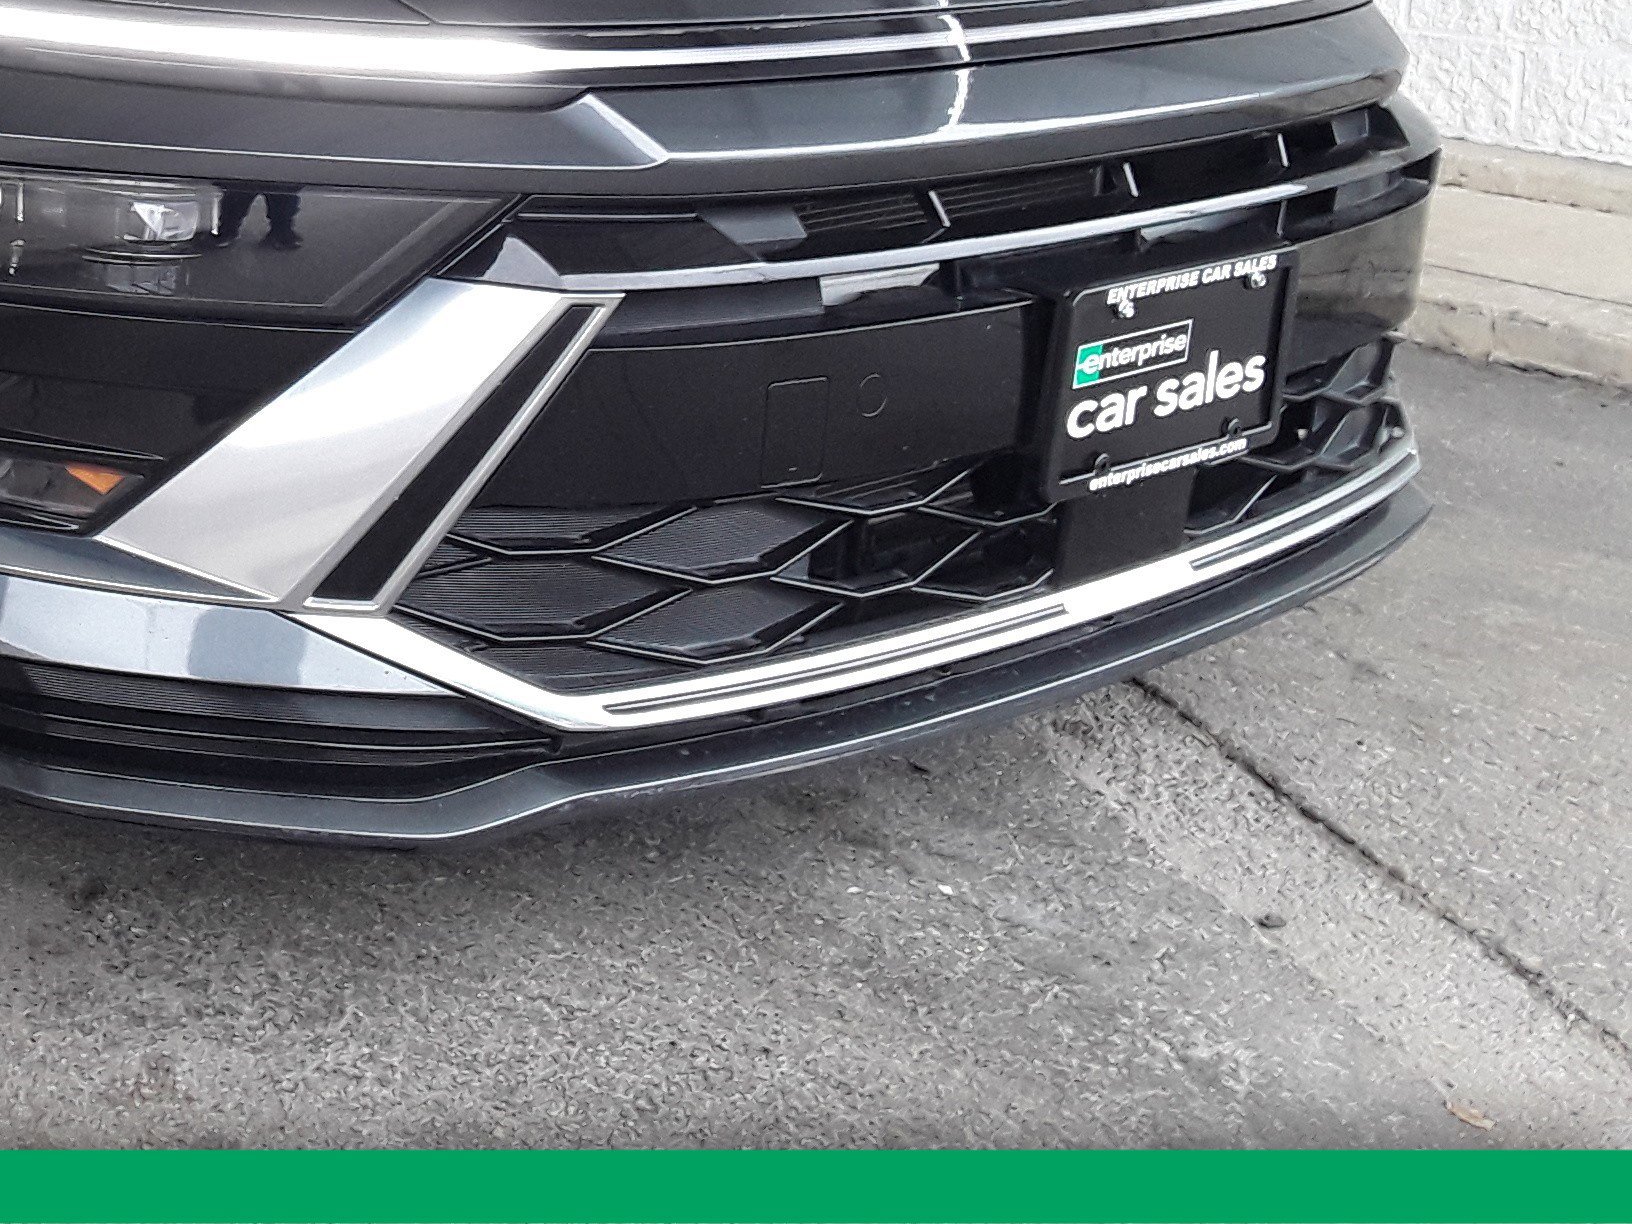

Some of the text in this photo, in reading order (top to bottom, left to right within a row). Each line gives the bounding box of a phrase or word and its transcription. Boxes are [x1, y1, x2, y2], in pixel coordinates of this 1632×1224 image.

[1106, 254, 1277, 305] ENTERPRISE CAR SALES
[1077, 333, 1188, 375] enterprise
[1067, 349, 1267, 439] car sales
[1089, 437, 1248, 491] enterprisecarsales.com
